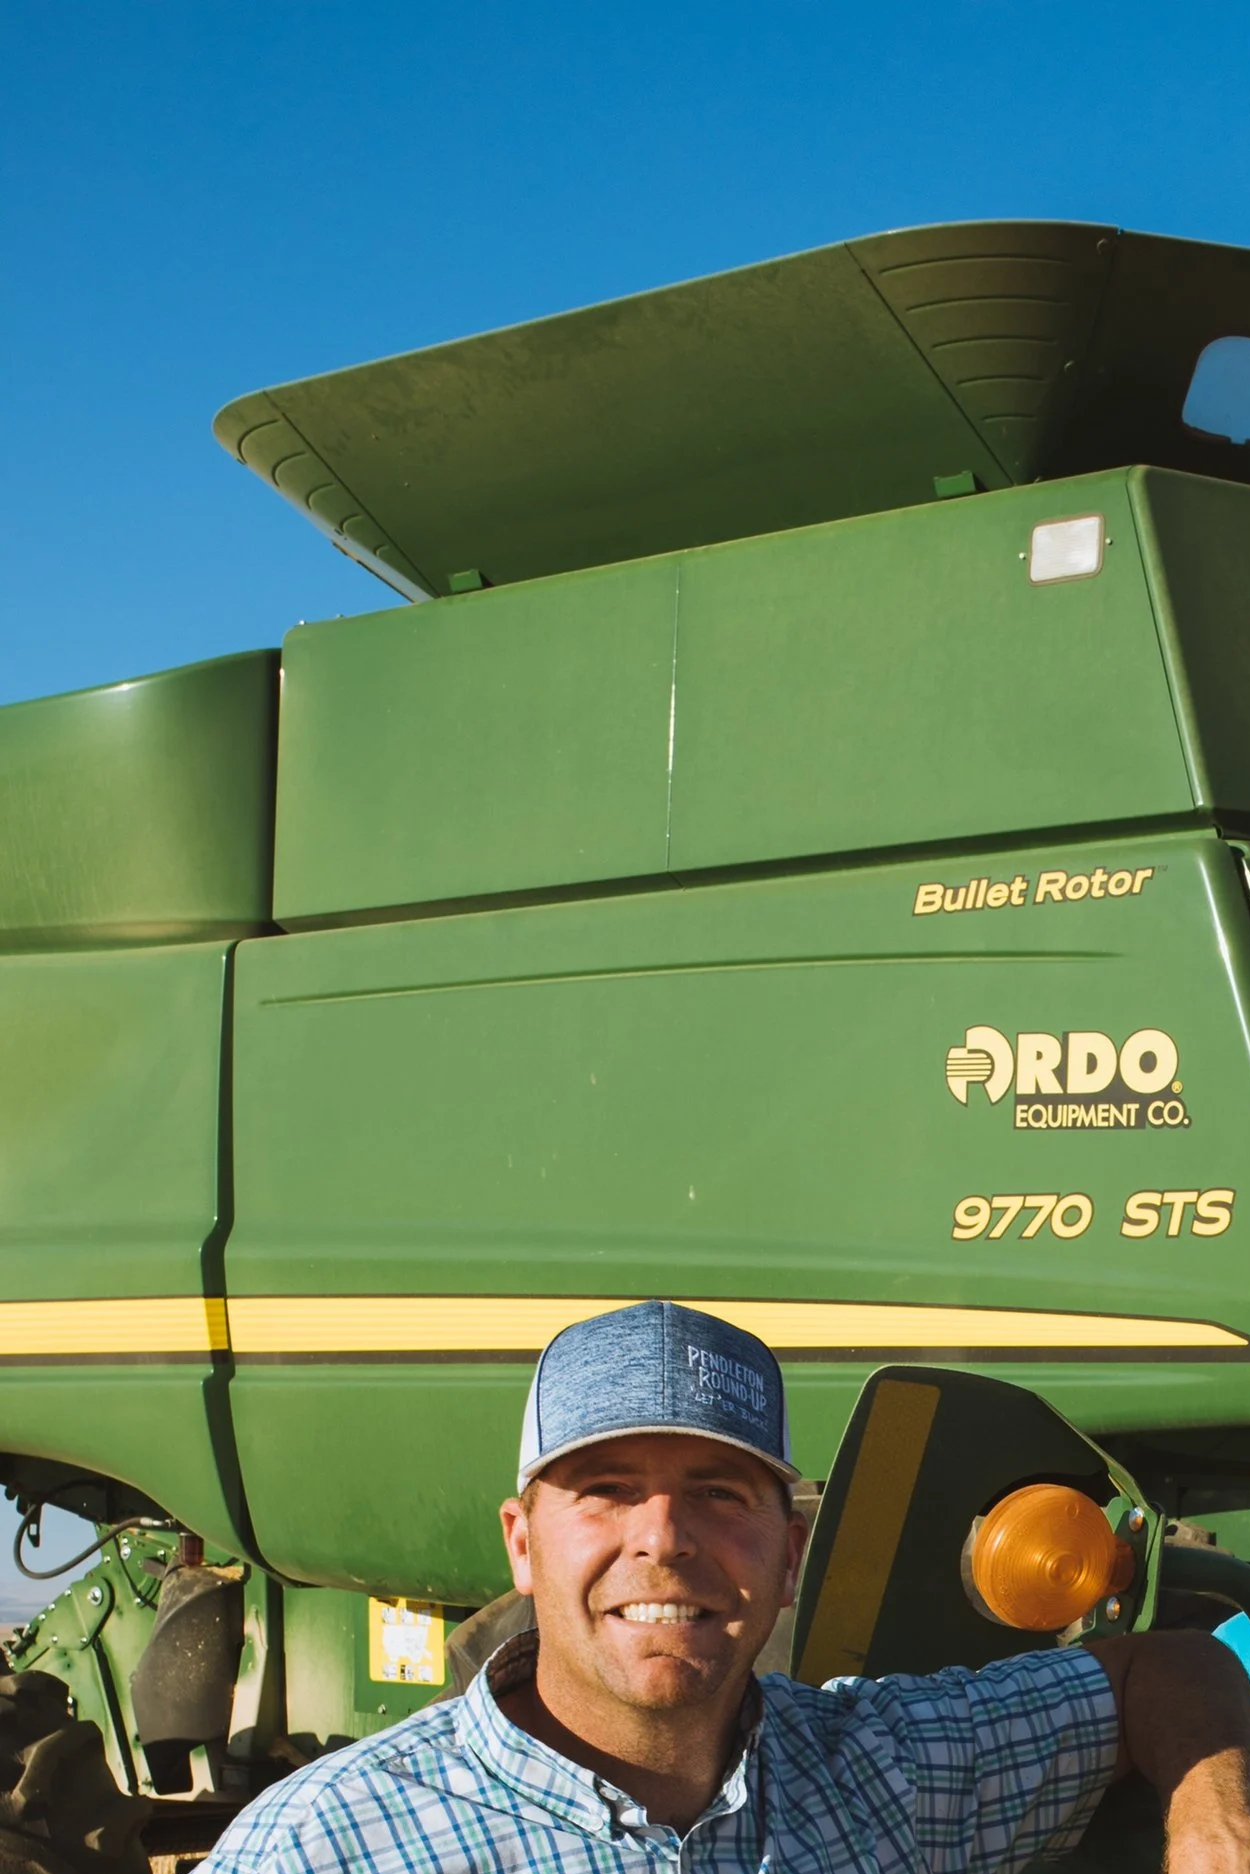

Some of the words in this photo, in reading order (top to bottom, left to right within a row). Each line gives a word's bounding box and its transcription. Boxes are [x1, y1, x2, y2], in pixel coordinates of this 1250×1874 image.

[912, 875, 1030, 915] Bullet
[1033, 866, 1156, 905] Rotor
[1015, 1027, 1180, 1095] RDO
[1014, 1103, 1140, 1129] EQUIPMENT
[1147, 1101, 1190, 1126] CO.
[951, 1193, 1094, 1241] 9770
[1120, 1188, 1236, 1239] STS
[687, 1345, 764, 1392] PENDLETON
[699, 1366, 767, 1412] ROUND-UP
